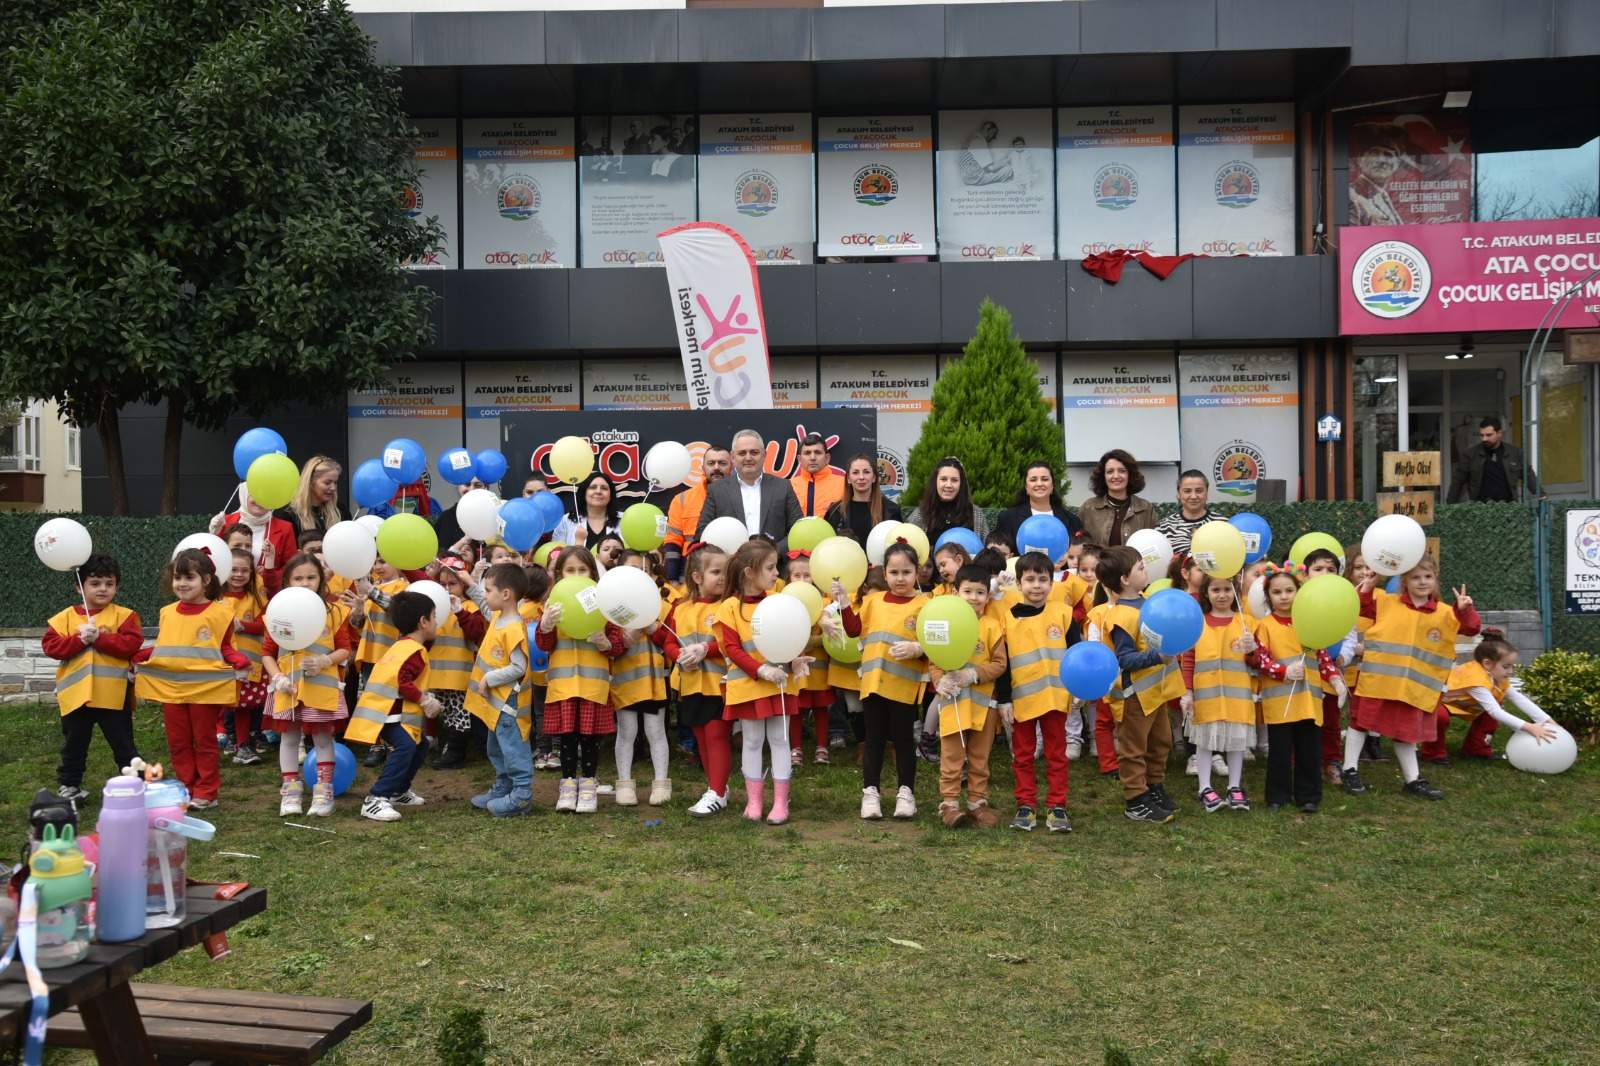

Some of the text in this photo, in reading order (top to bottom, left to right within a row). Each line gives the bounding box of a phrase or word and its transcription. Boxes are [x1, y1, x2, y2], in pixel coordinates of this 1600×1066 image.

[1462, 238, 1488, 248] T.C.
[1491, 234, 1552, 248] ATAKUM
[603, 248, 664, 264] ataçocu
[1484, 256, 1530, 274] ATA
[1364, 256, 1384, 294] ATAKUM
[1438, 284, 1504, 308] ÇOCUK
[1506, 277, 1582, 304] GELİŞİM
[1115, 374, 1172, 384] BELEDİYESİ
[1190, 372, 1290, 383] ATAKUM BELEDİYESİ
[592, 382, 688, 392] ATAKUM BELEDİYES
[772, 380, 810, 390] EDİYESİ
[830, 378, 929, 389] ATAKUM BELEDİYESİ
[399, 384, 455, 395] BELEDİYESİ
[474, 384, 572, 394] ATAKUM BELEDİYESİ
[1094, 386, 1152, 395] ATAÇOCUK
[1210, 384, 1270, 394] ATAÇOCUK
[1076, 396, 1166, 406] ÇOCUK GELİŞİM MERKEZİ
[1194, 396, 1284, 406] ÇOCUK GELİŞİM MERKEZİ
[362, 408, 386, 416] ÇOCUK
[416, 407, 448, 415] MERKEZİ
[480, 409, 500, 417] ÇOCU
[593, 429, 639, 442] atakum
